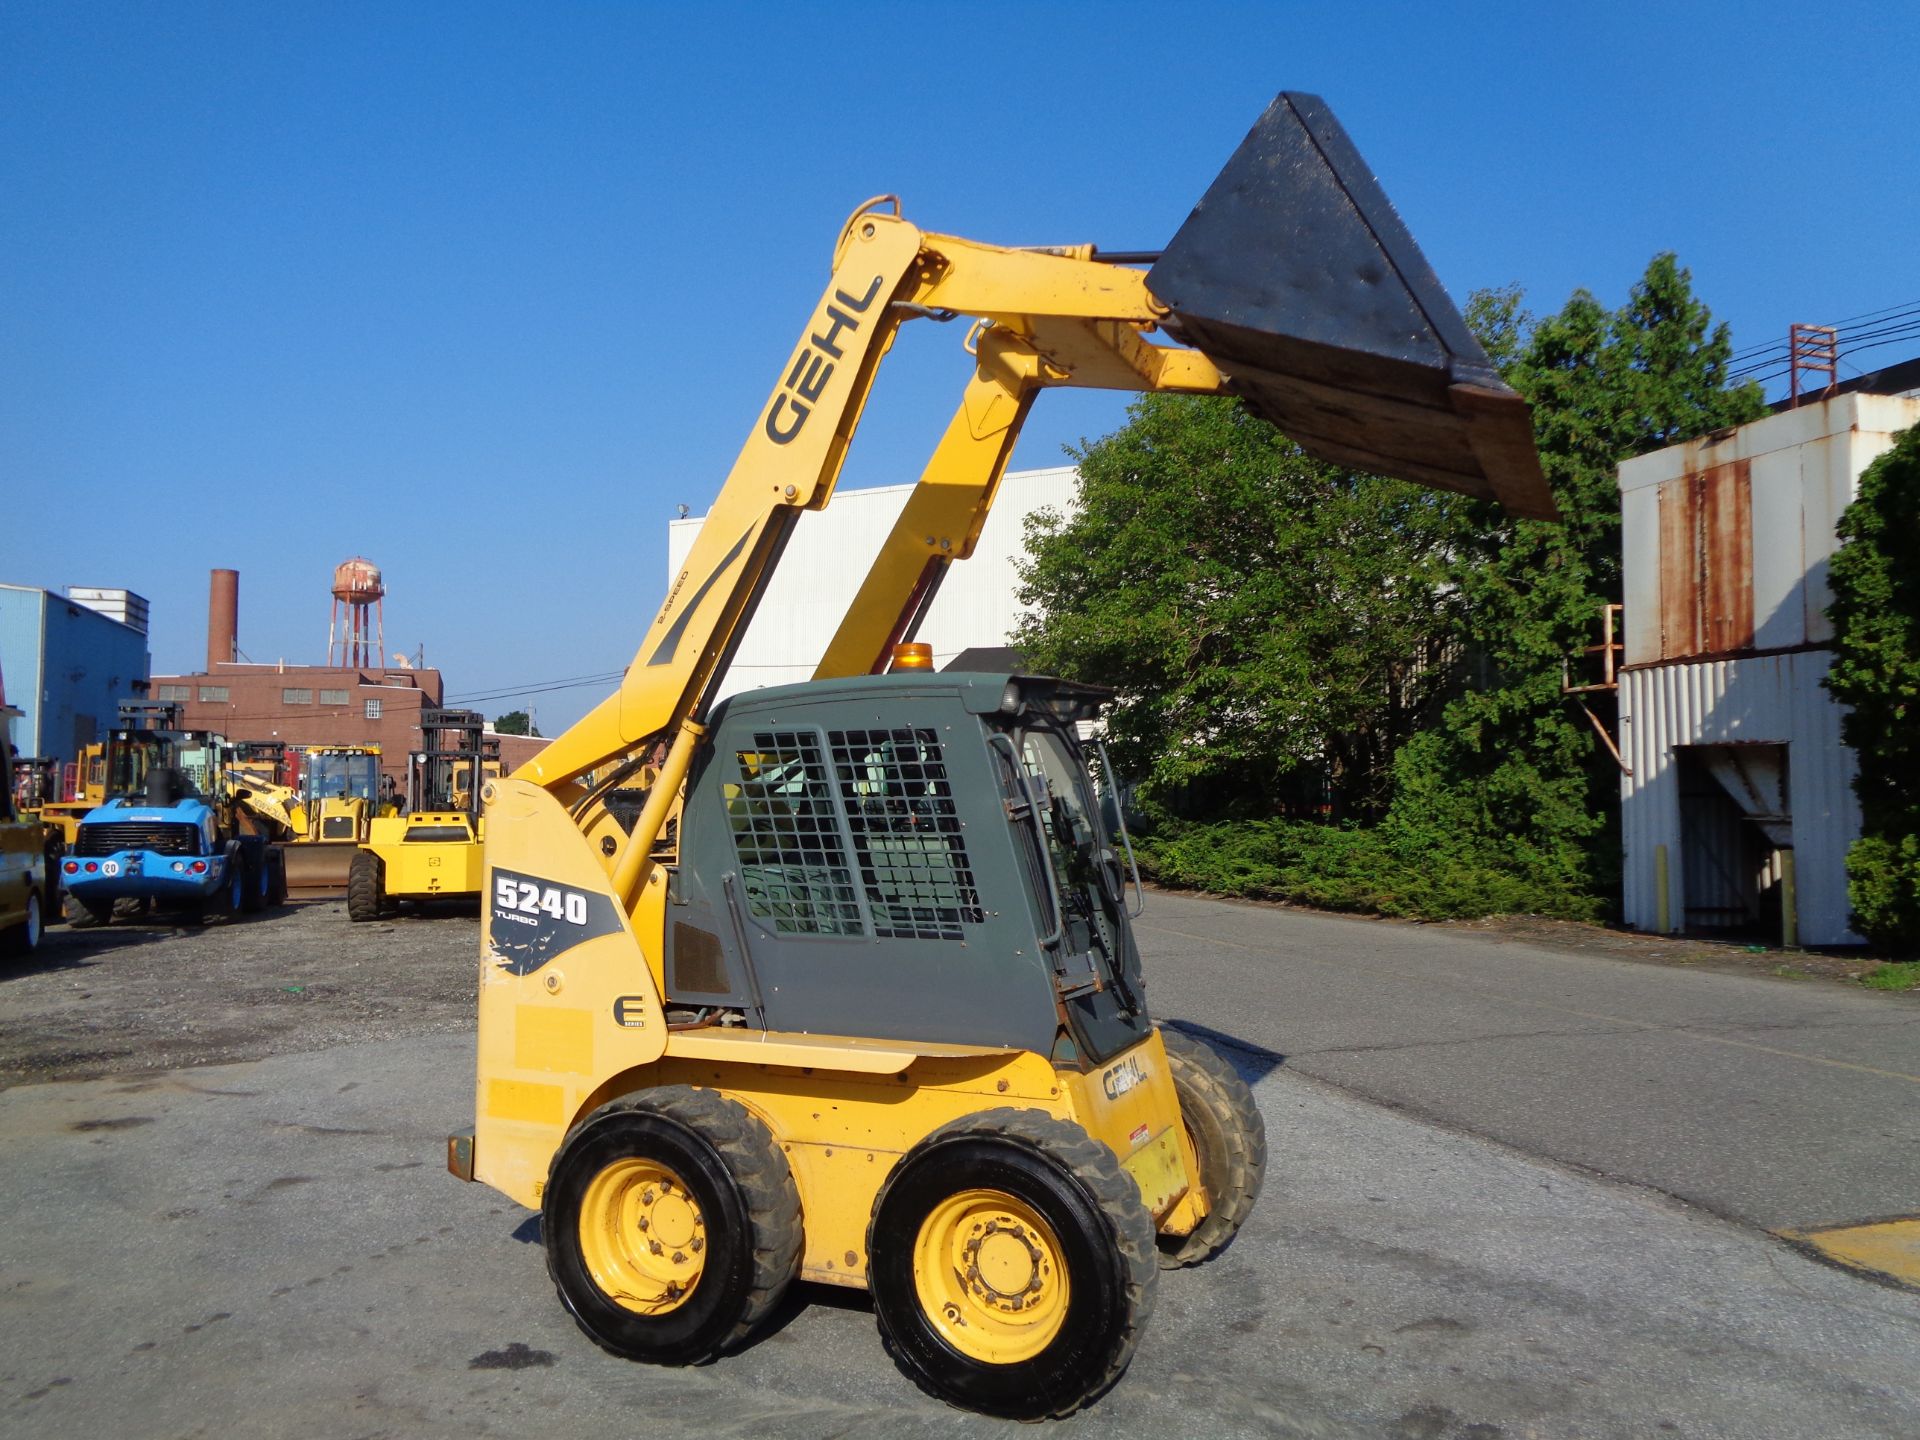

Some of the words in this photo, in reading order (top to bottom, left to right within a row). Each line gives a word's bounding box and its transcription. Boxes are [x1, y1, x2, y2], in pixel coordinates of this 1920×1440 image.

[766, 275, 883, 445] GEHL
[657, 571, 688, 624] 2-SPEED
[105, 864, 116, 873] 20
[495, 910, 538, 926] TURBO
[497, 876, 587, 926] 5240
